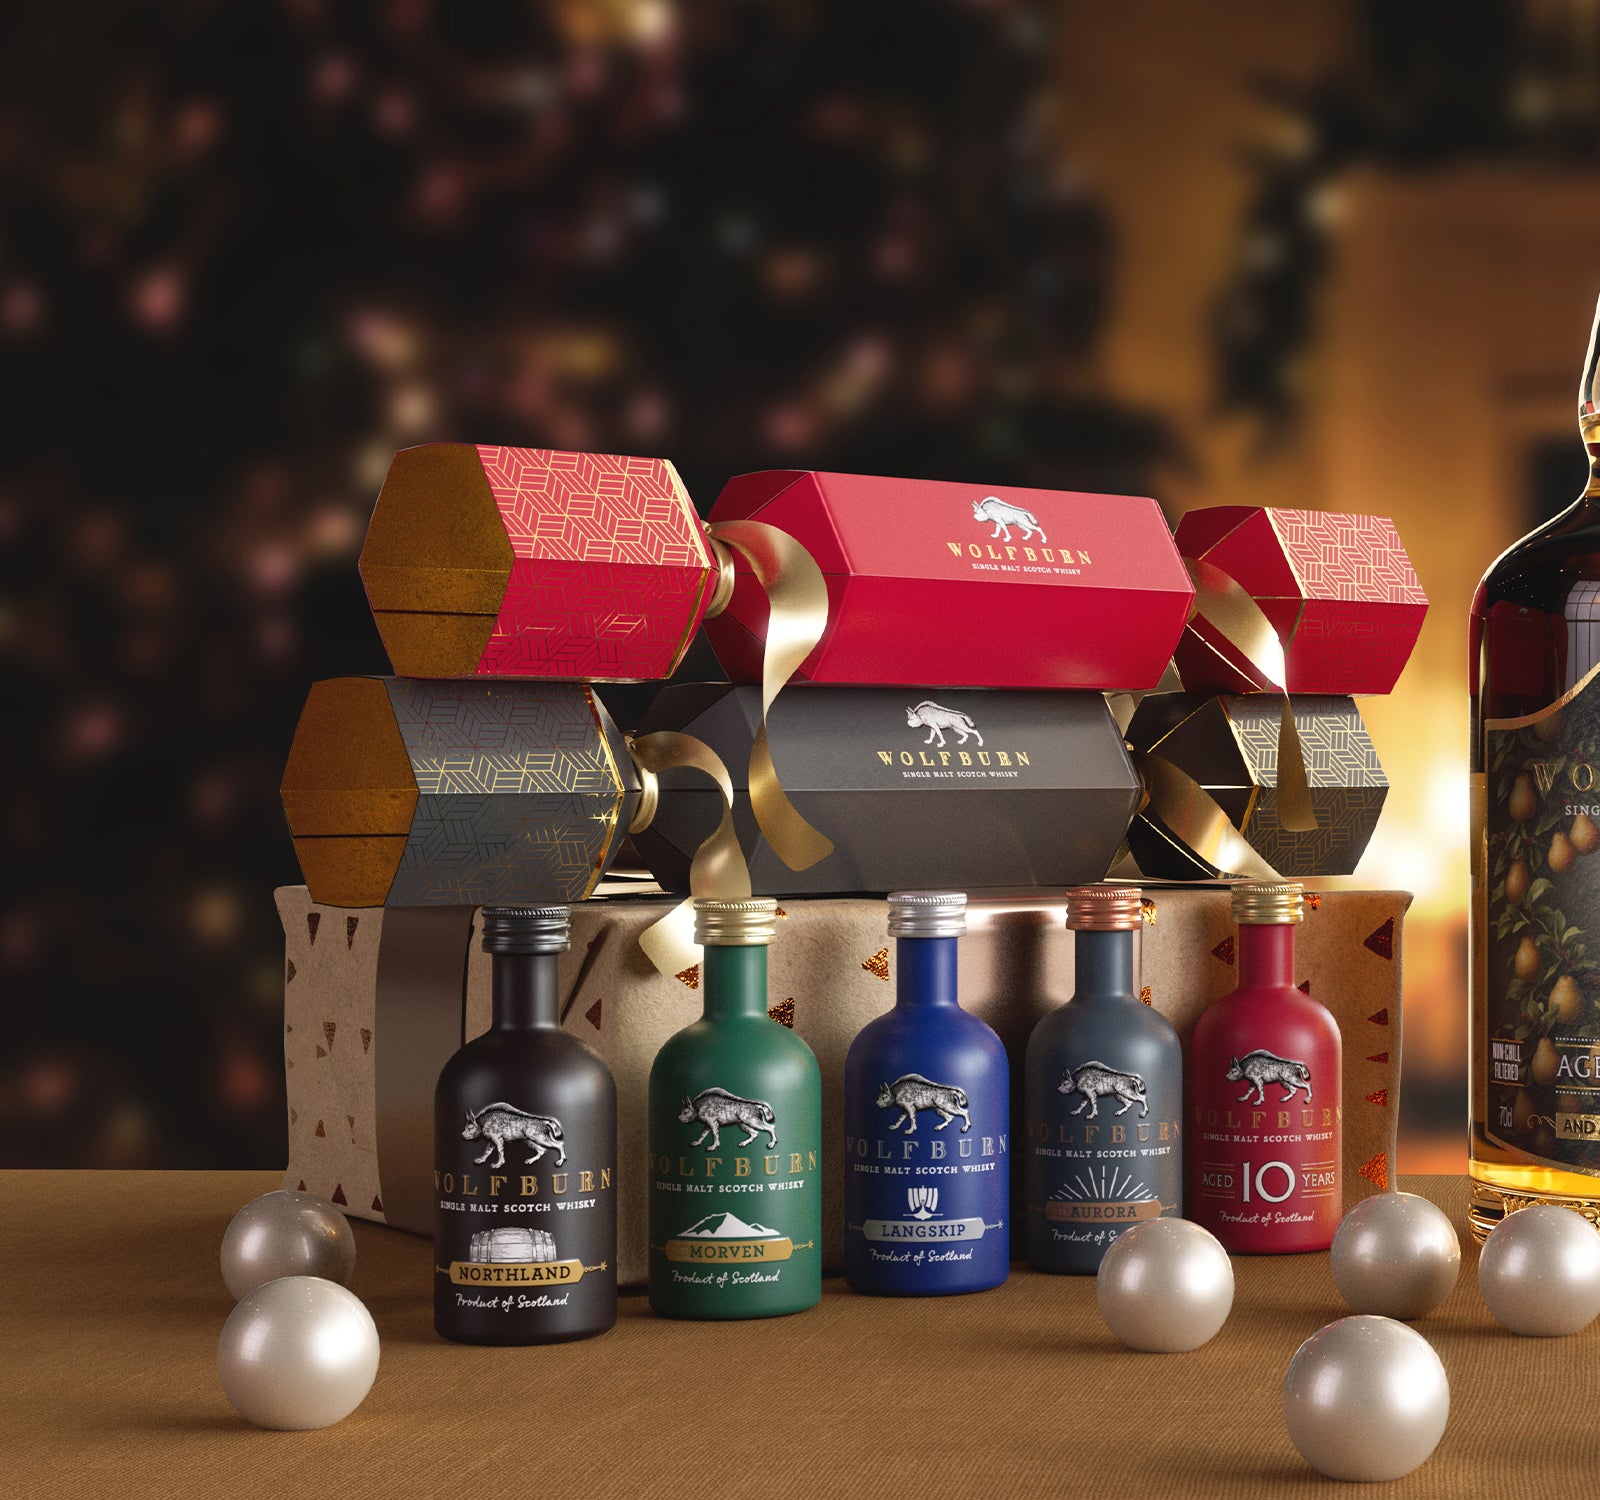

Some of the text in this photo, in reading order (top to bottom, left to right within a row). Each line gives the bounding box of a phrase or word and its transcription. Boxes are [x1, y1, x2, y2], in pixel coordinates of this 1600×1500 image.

[946, 542, 1092, 565] WOLFBURN
[972, 563, 1081, 576] SINGLE MALT SCOTCH WHISKY
[876, 751, 1031, 766] WOLFBURN
[1492, 1042, 1521, 1062] NON-CHILL
[1494, 1062, 1519, 1081] FILTERED
[1499, 1106, 1513, 1128] 70cl
[1563, 1119, 1595, 1135] AND
[1203, 1131, 1333, 1143] SINGLE MALT SCOTCH WHISKY
[1035, 1146, 1171, 1158] SINGLE MALT SCOTCH WHISKY
[854, 1162, 996, 1175] SINGLE MALT SCOTCH WHISKY
[656, 1180, 805, 1193] SINGLE MALT SCOTCH WHISKY
[1202, 1160, 1335, 1203] AGED 10 YEARS
[440, 1199, 597, 1213] SINGLE MALT SCOTCH WHISKY
[1070, 1206, 1137, 1219] AURORA
[1219, 1210, 1315, 1227] Product of Scotland
[881, 1223, 966, 1238] LANGSKIP
[1051, 1228, 1091, 1242] Product
[1094, 1230, 1105, 1246] of
[689, 1244, 766, 1259] MORVEN
[869, 1248, 974, 1266] Product of Scotland
[458, 1265, 571, 1282] NORTHLAND
[671, 1269, 780, 1288] Product of Scotland
[455, 1292, 570, 1313] Product of Scotland
